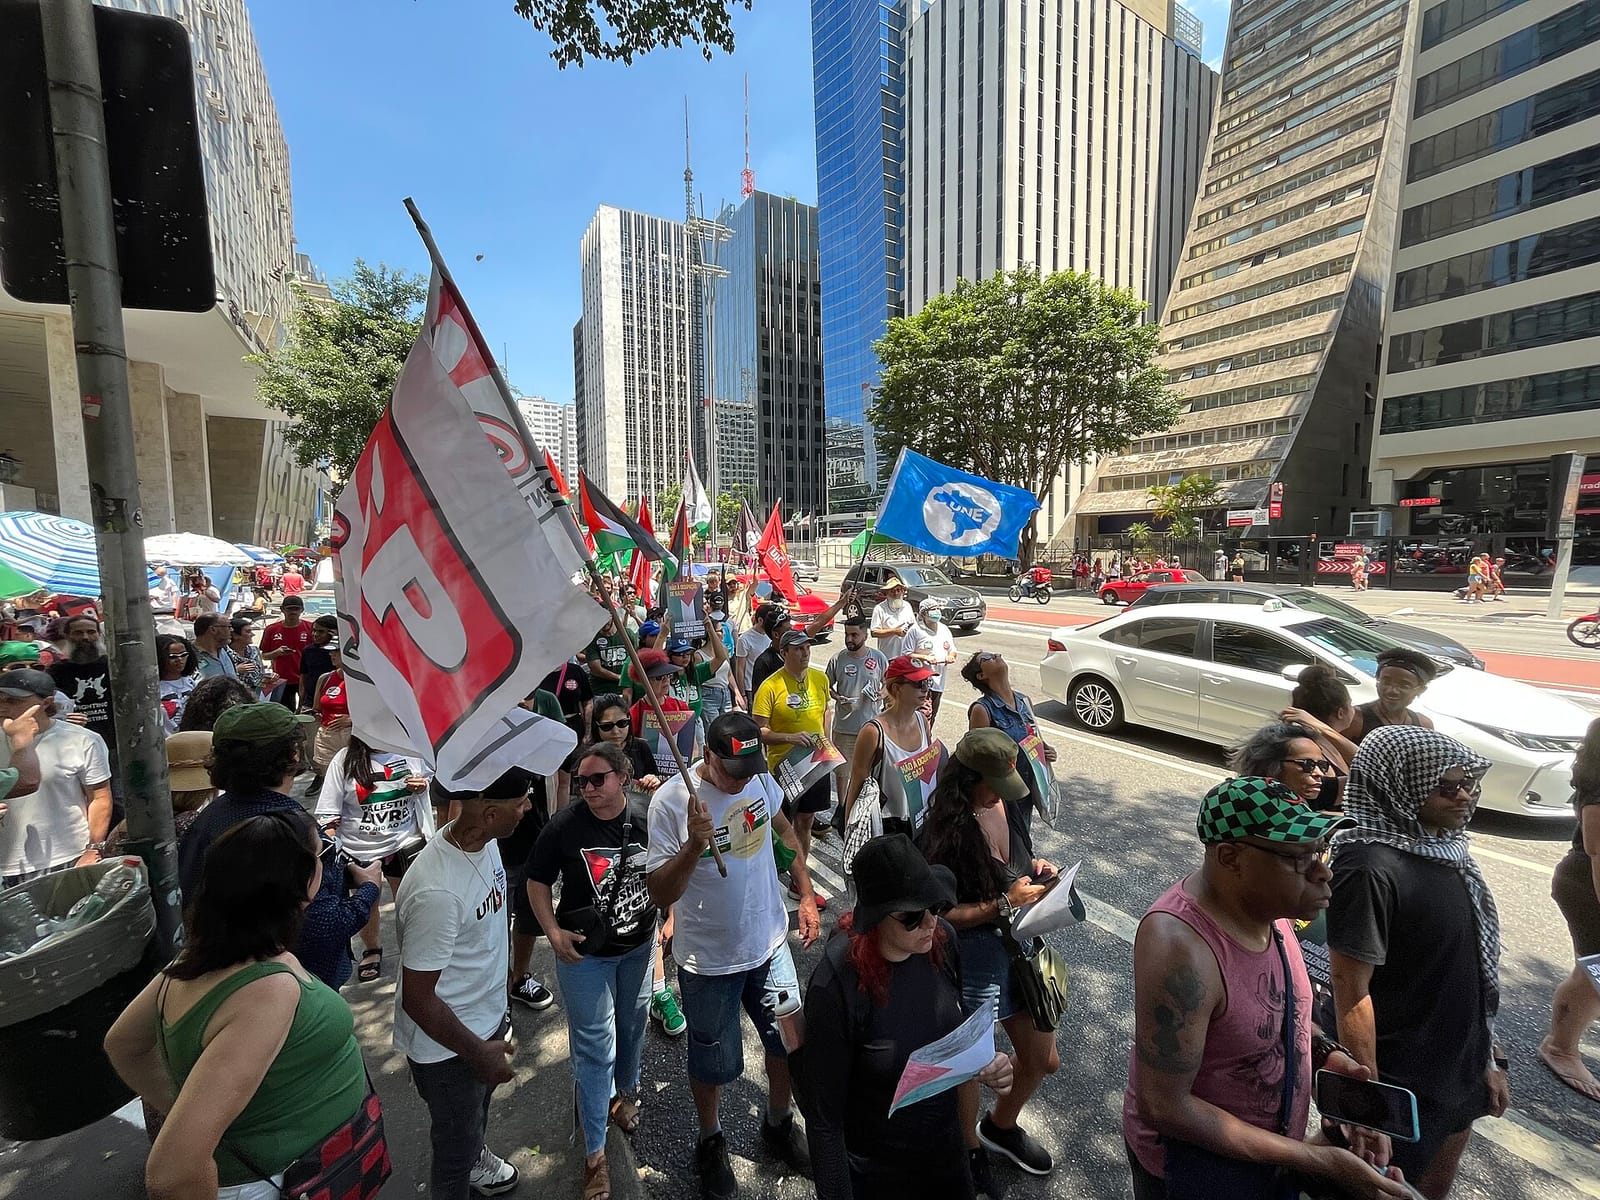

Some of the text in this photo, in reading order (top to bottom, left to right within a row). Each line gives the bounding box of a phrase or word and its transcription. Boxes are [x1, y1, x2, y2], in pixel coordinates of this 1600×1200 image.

[949, 501, 983, 523] UNE
[769, 550, 785, 565] UJC
[665, 712, 687, 722] CUPAÇÃO
[900, 761, 913, 774] NÃO
[904, 767, 925, 783] DE GAZA
[388, 822, 399, 830] AO
